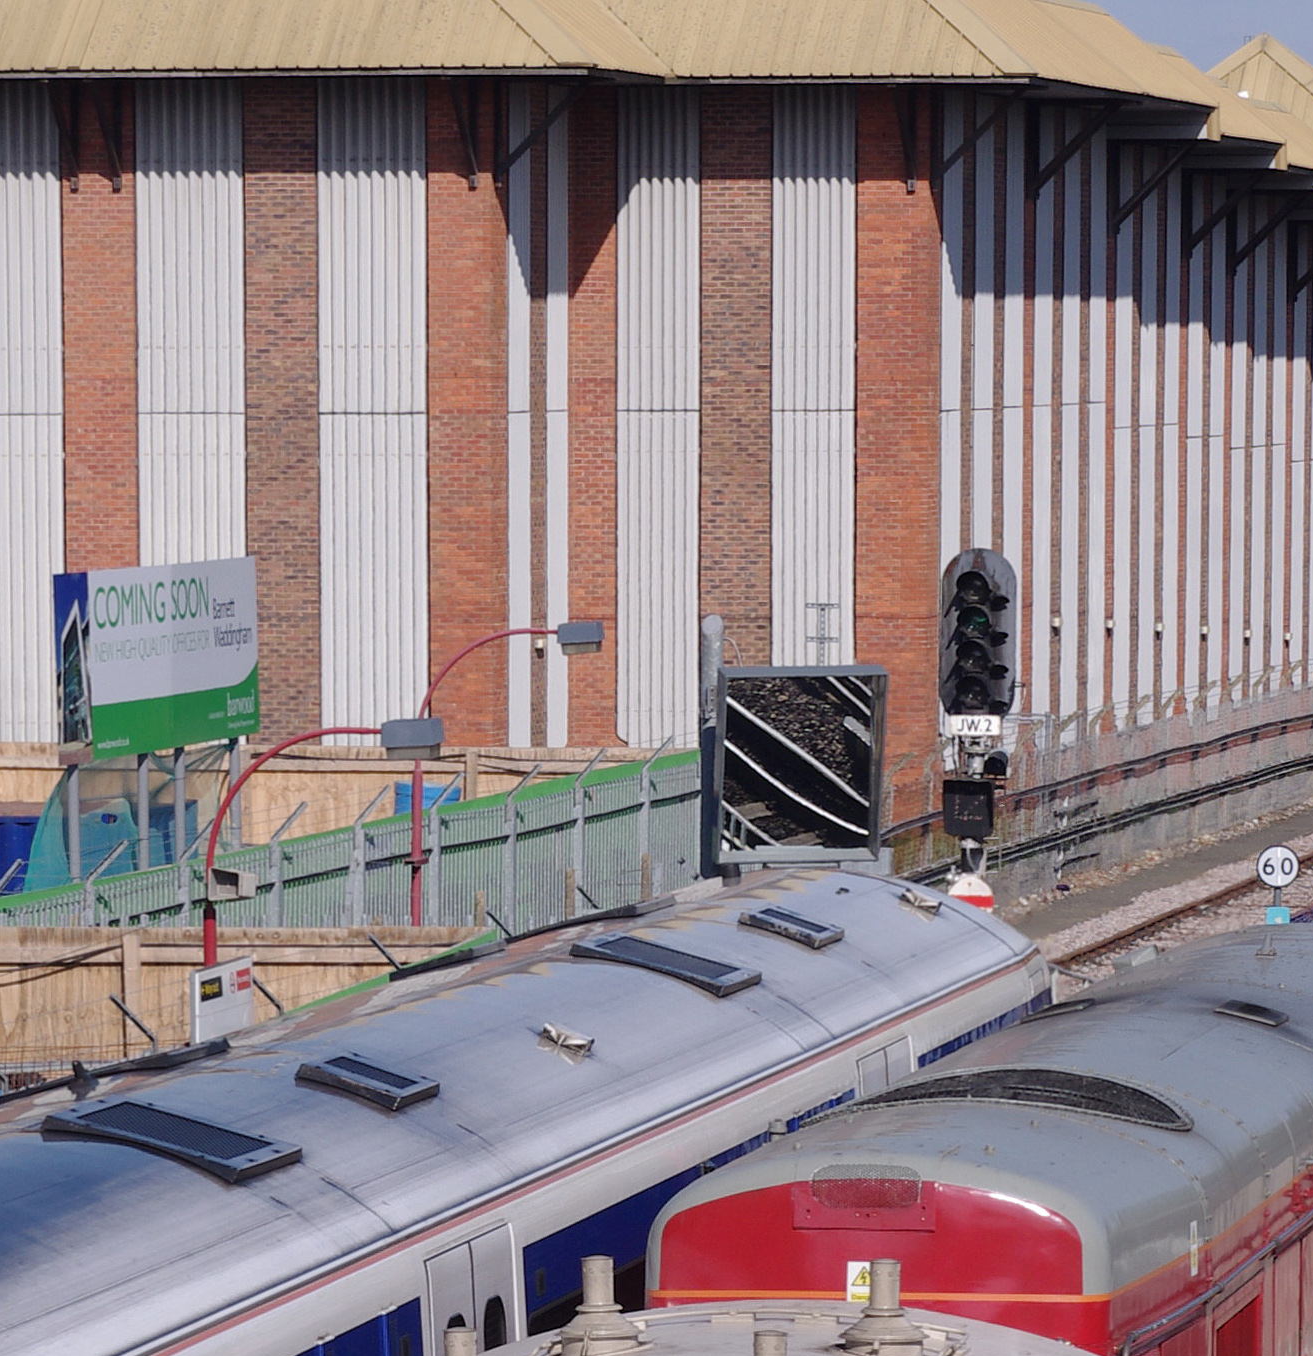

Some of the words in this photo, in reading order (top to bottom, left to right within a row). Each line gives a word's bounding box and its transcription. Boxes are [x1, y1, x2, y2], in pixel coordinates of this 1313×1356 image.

[94, 581, 166, 629] COMING
[171, 576, 209, 621] SOON
[956, 718, 992, 733] JW.2
[1263, 857, 1293, 876] 60
